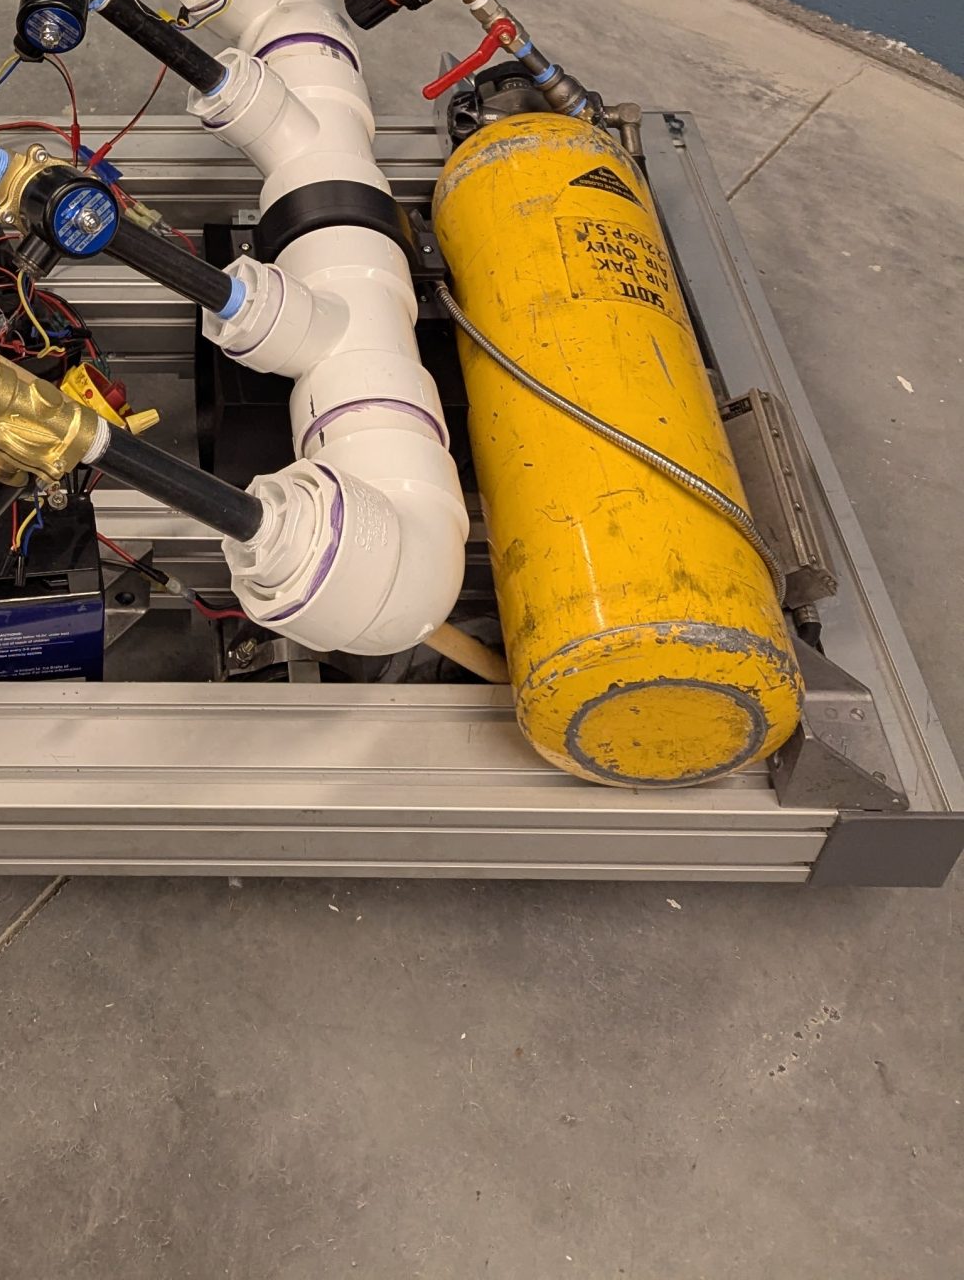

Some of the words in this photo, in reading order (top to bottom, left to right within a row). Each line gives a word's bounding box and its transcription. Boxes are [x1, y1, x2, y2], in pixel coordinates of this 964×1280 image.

[586, 240, 638, 261] ONLY
[596, 257, 669, 293] AIR-PAK
[643, 254, 668, 278] AIR
[620, 281, 666, 311] SCOTT
